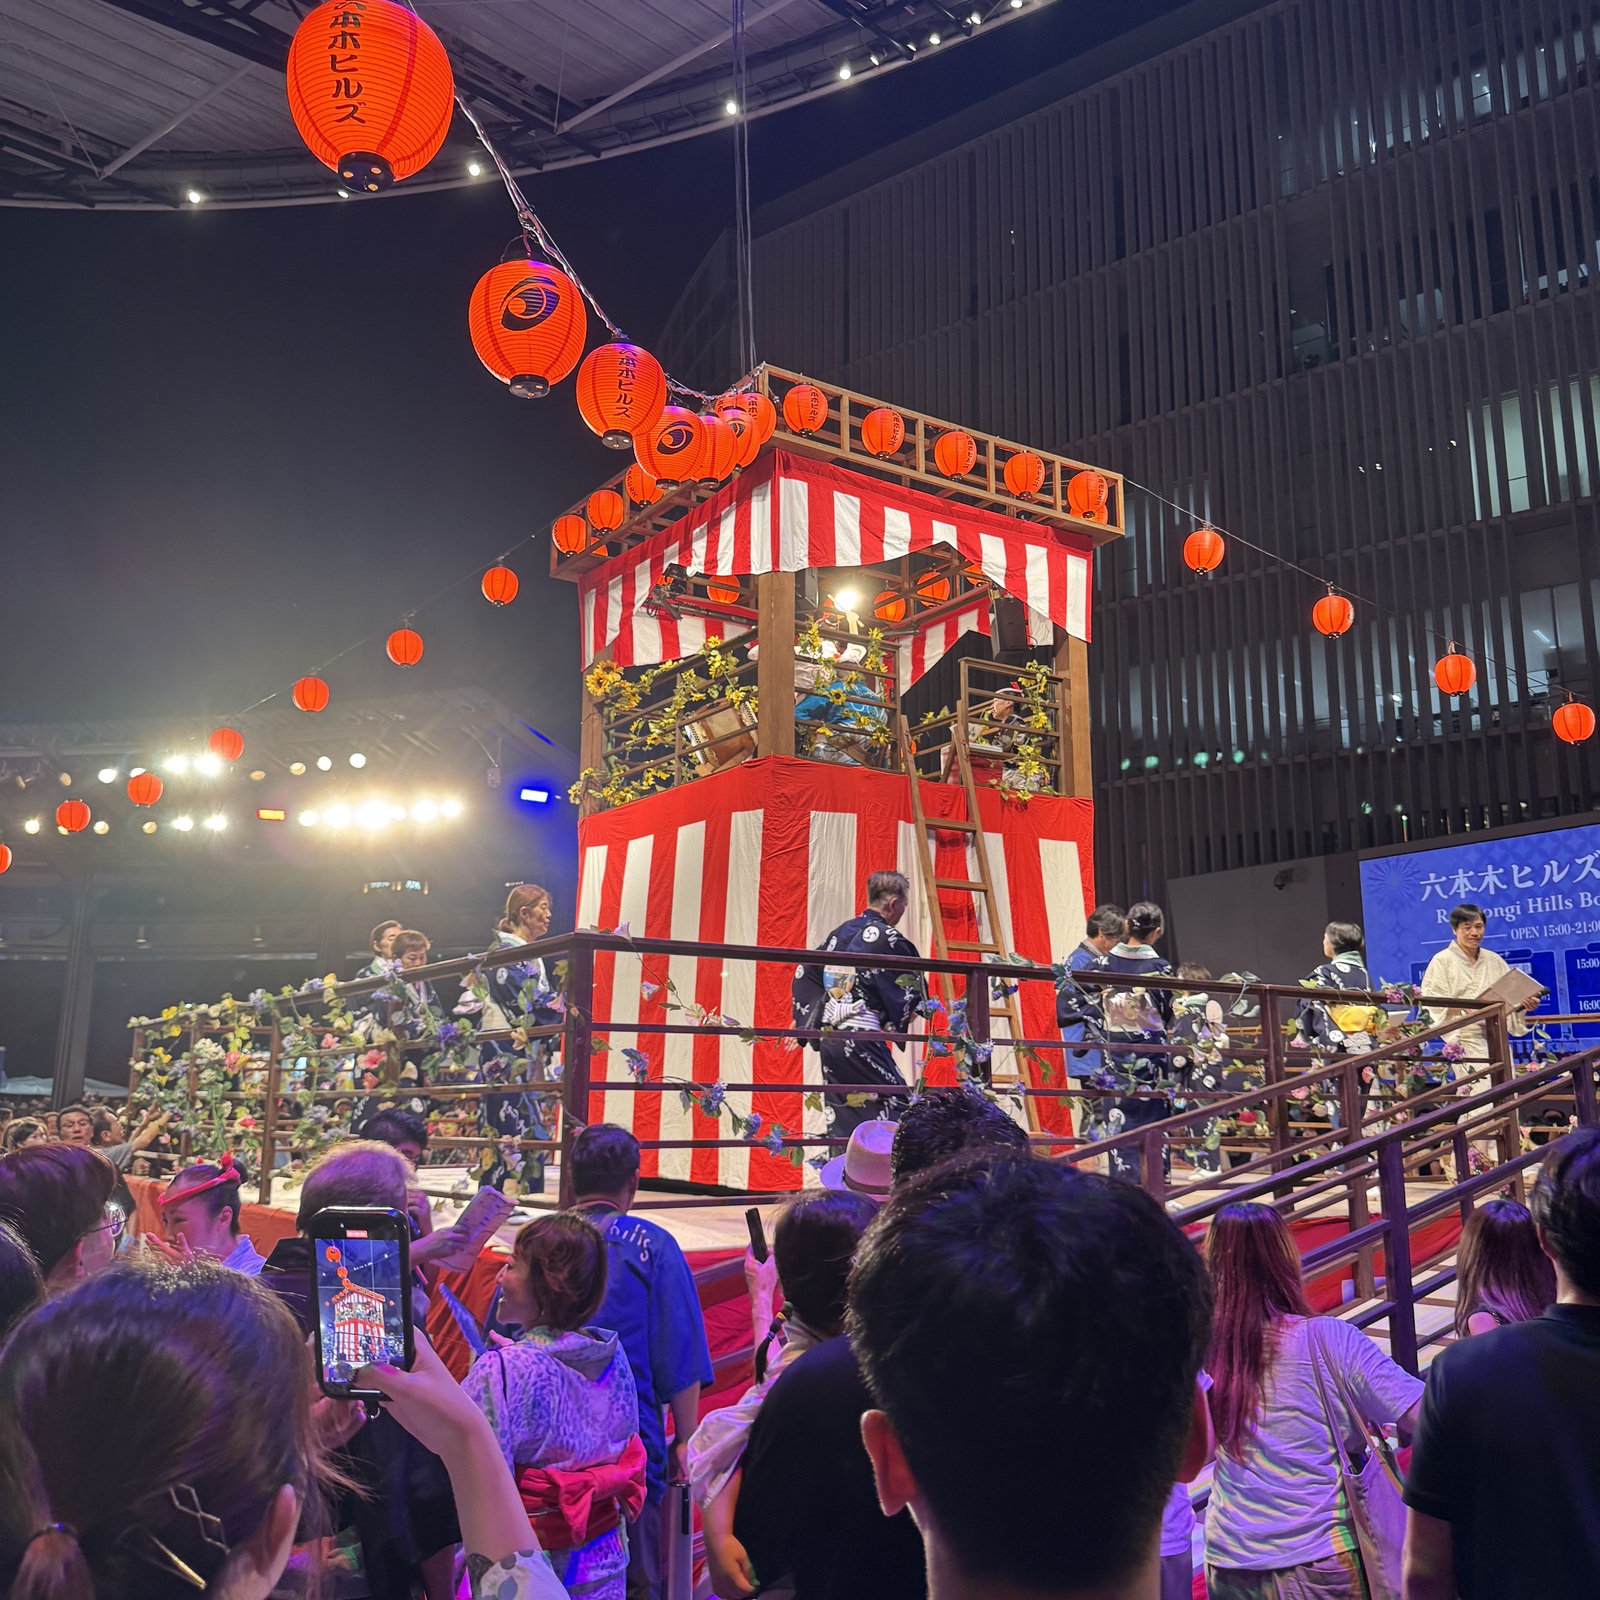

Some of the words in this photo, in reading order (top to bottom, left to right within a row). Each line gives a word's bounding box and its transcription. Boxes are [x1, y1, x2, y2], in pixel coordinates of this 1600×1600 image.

[1419, 850, 1600, 901] 六本木ヒルズ
[1436, 903, 1522, 924] Rongi
[1527, 894, 1573, 914] Hills
[1511, 925, 1540, 941] OPEN
